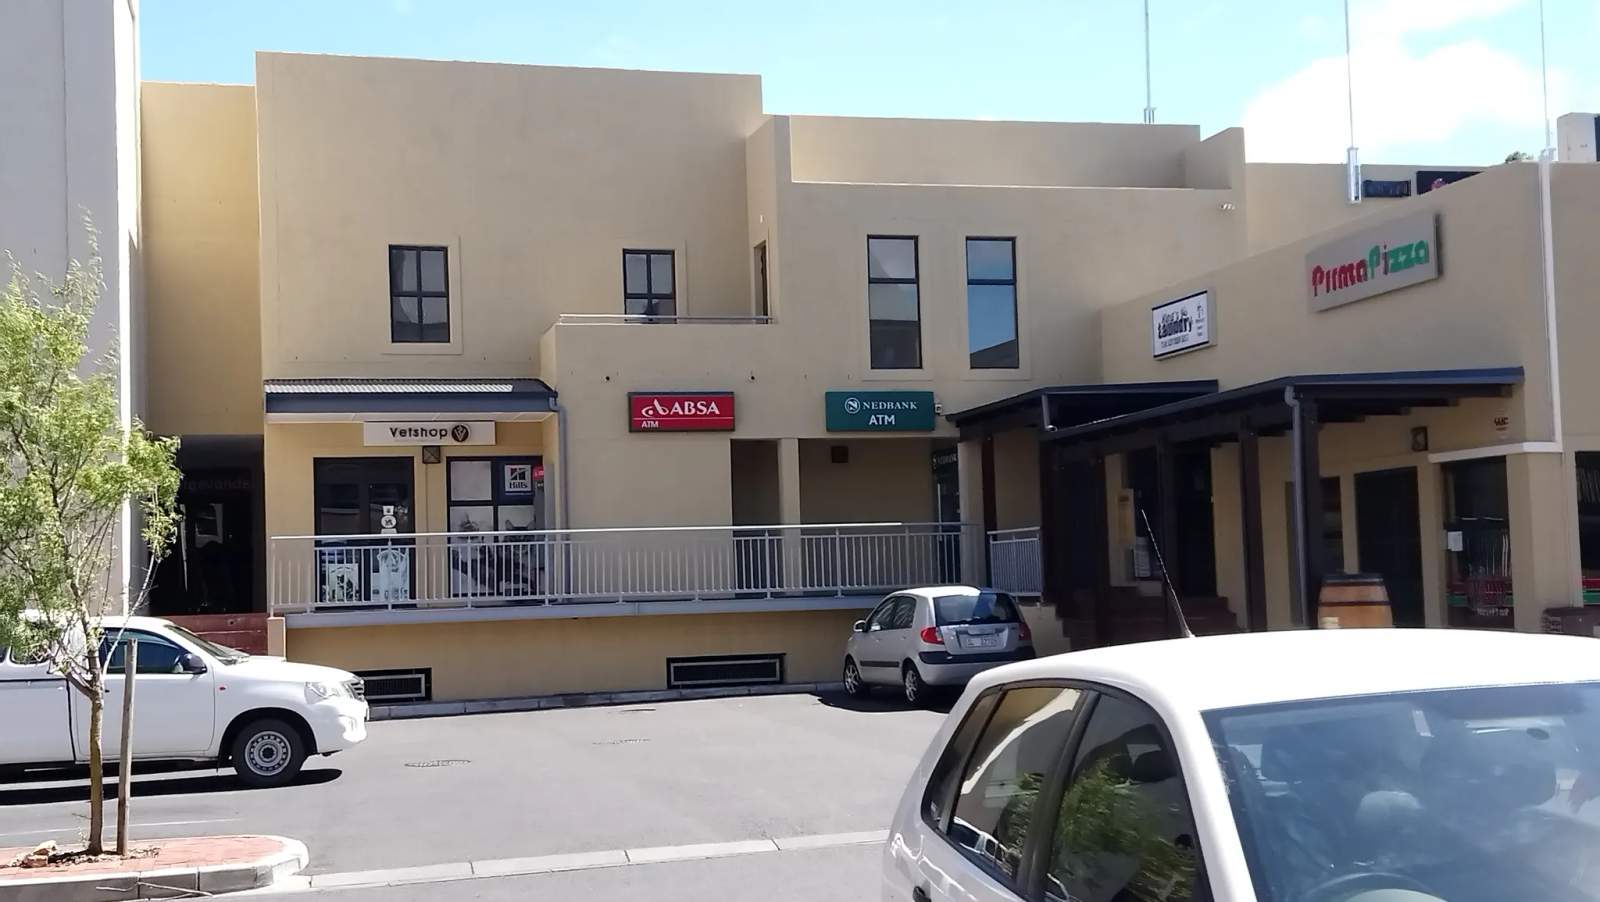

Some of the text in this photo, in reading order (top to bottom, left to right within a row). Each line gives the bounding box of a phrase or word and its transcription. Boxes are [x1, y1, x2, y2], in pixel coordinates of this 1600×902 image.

[670, 401, 720, 415] ABSA
[863, 401, 918, 410] NEDBANK
[641, 420, 659, 428] ATM
[869, 415, 896, 425] ATM
[390, 427, 448, 440] Vetshop
